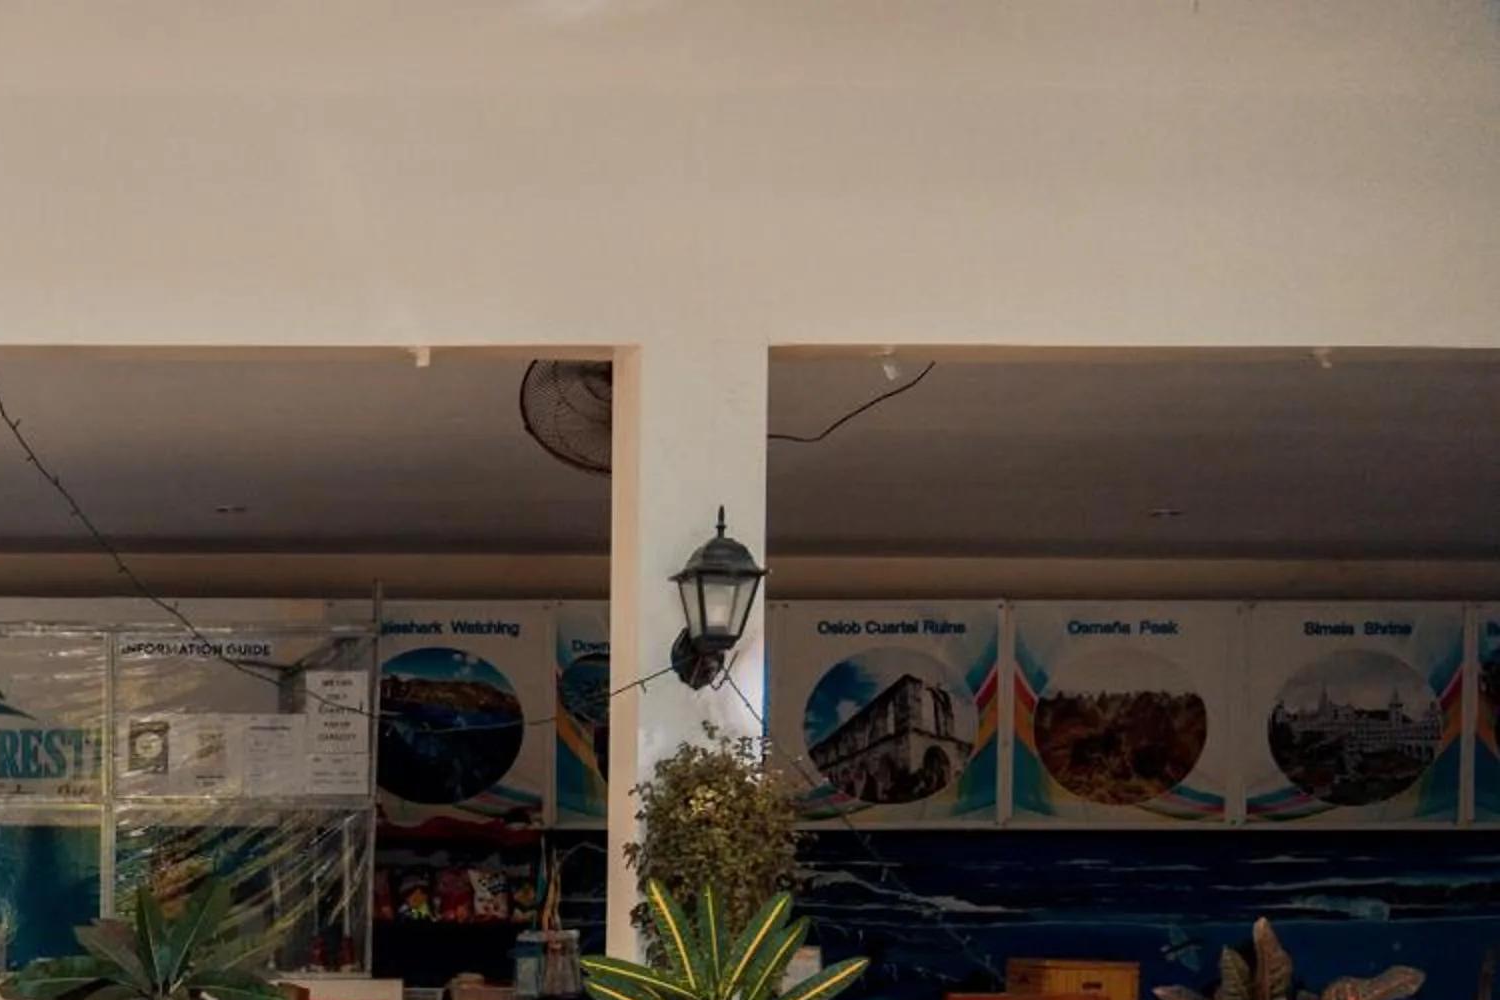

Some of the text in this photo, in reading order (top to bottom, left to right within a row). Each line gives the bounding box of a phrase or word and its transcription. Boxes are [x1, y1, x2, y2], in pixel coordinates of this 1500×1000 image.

[450, 621, 520, 637] Watching
[817, 620, 965, 634] Oslob Cuartel Ruins
[1140, 620, 1179, 634] Peak
[1364, 621, 1412, 636] Shrine
[122, 643, 271, 657] INFORMATION GUIDE
